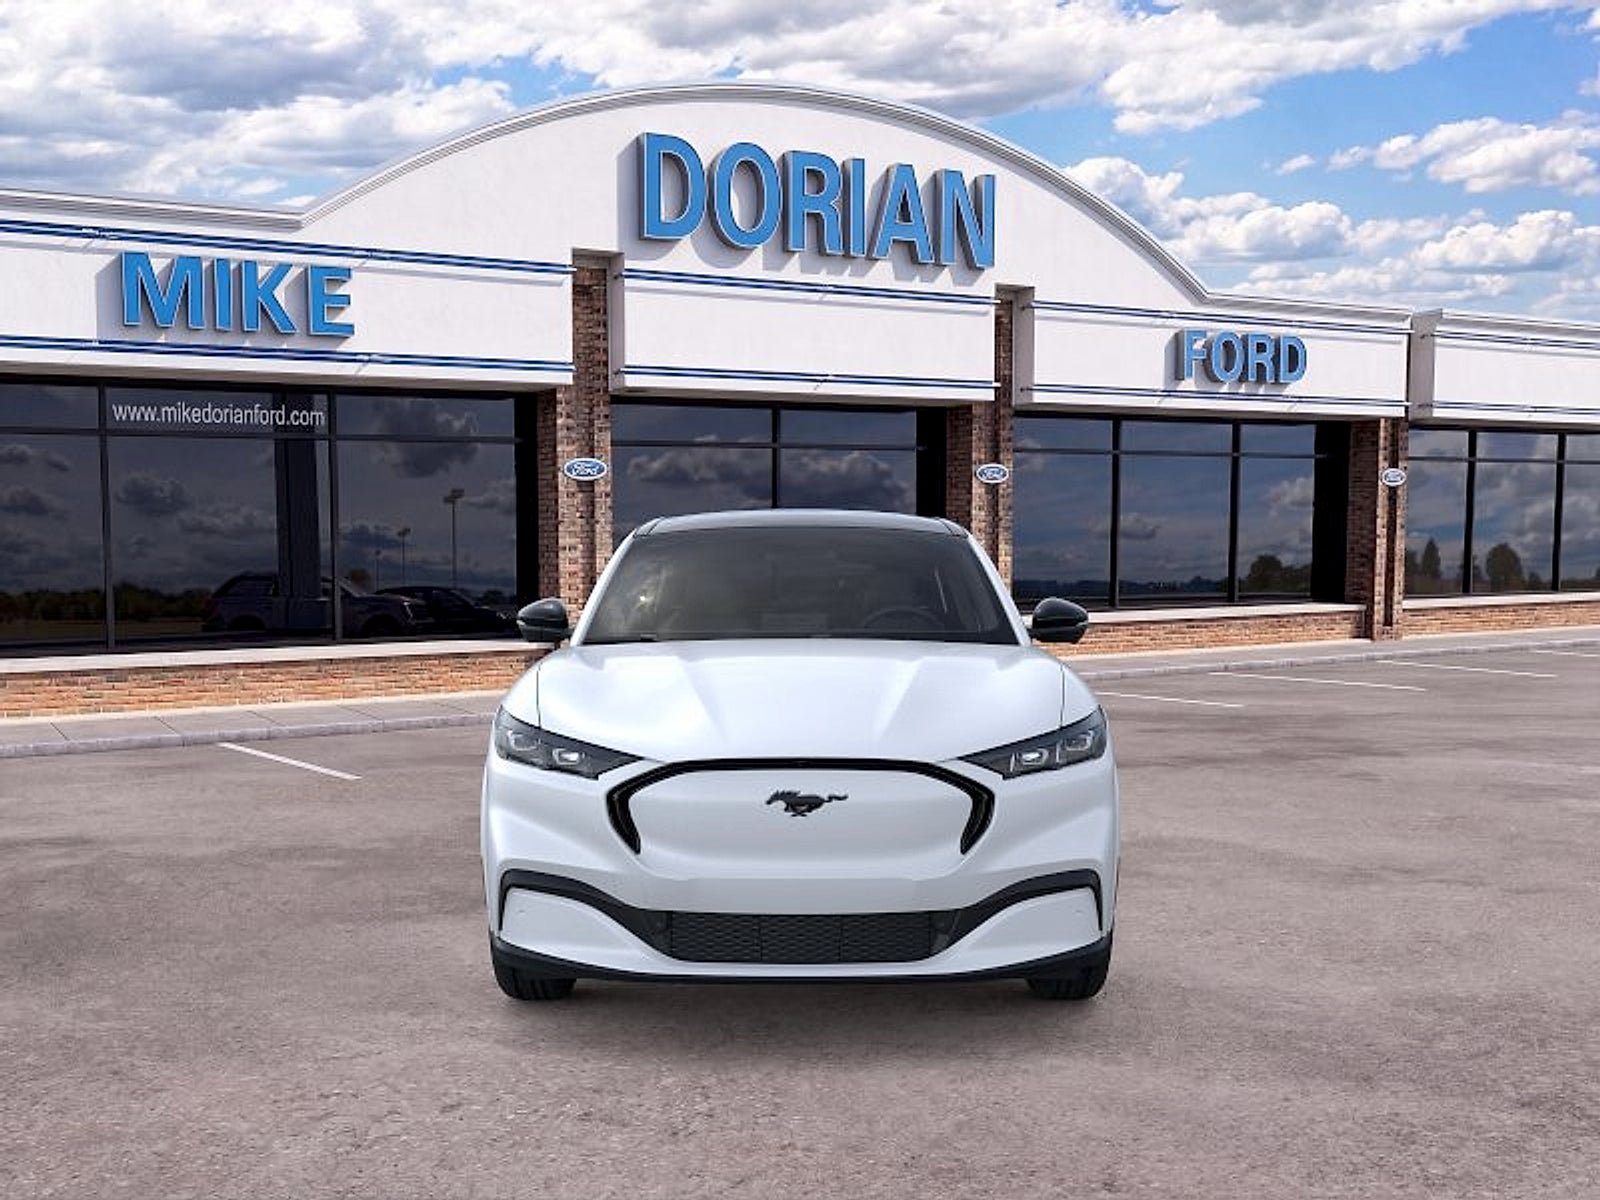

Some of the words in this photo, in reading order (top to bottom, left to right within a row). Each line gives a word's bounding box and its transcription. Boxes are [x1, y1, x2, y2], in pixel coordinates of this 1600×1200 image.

[639, 132, 996, 270] DORIAN
[120, 251, 356, 337] MIKE
[1178, 329, 1307, 384] FORD
[112, 402, 325, 426] www.mikedorianford.com
